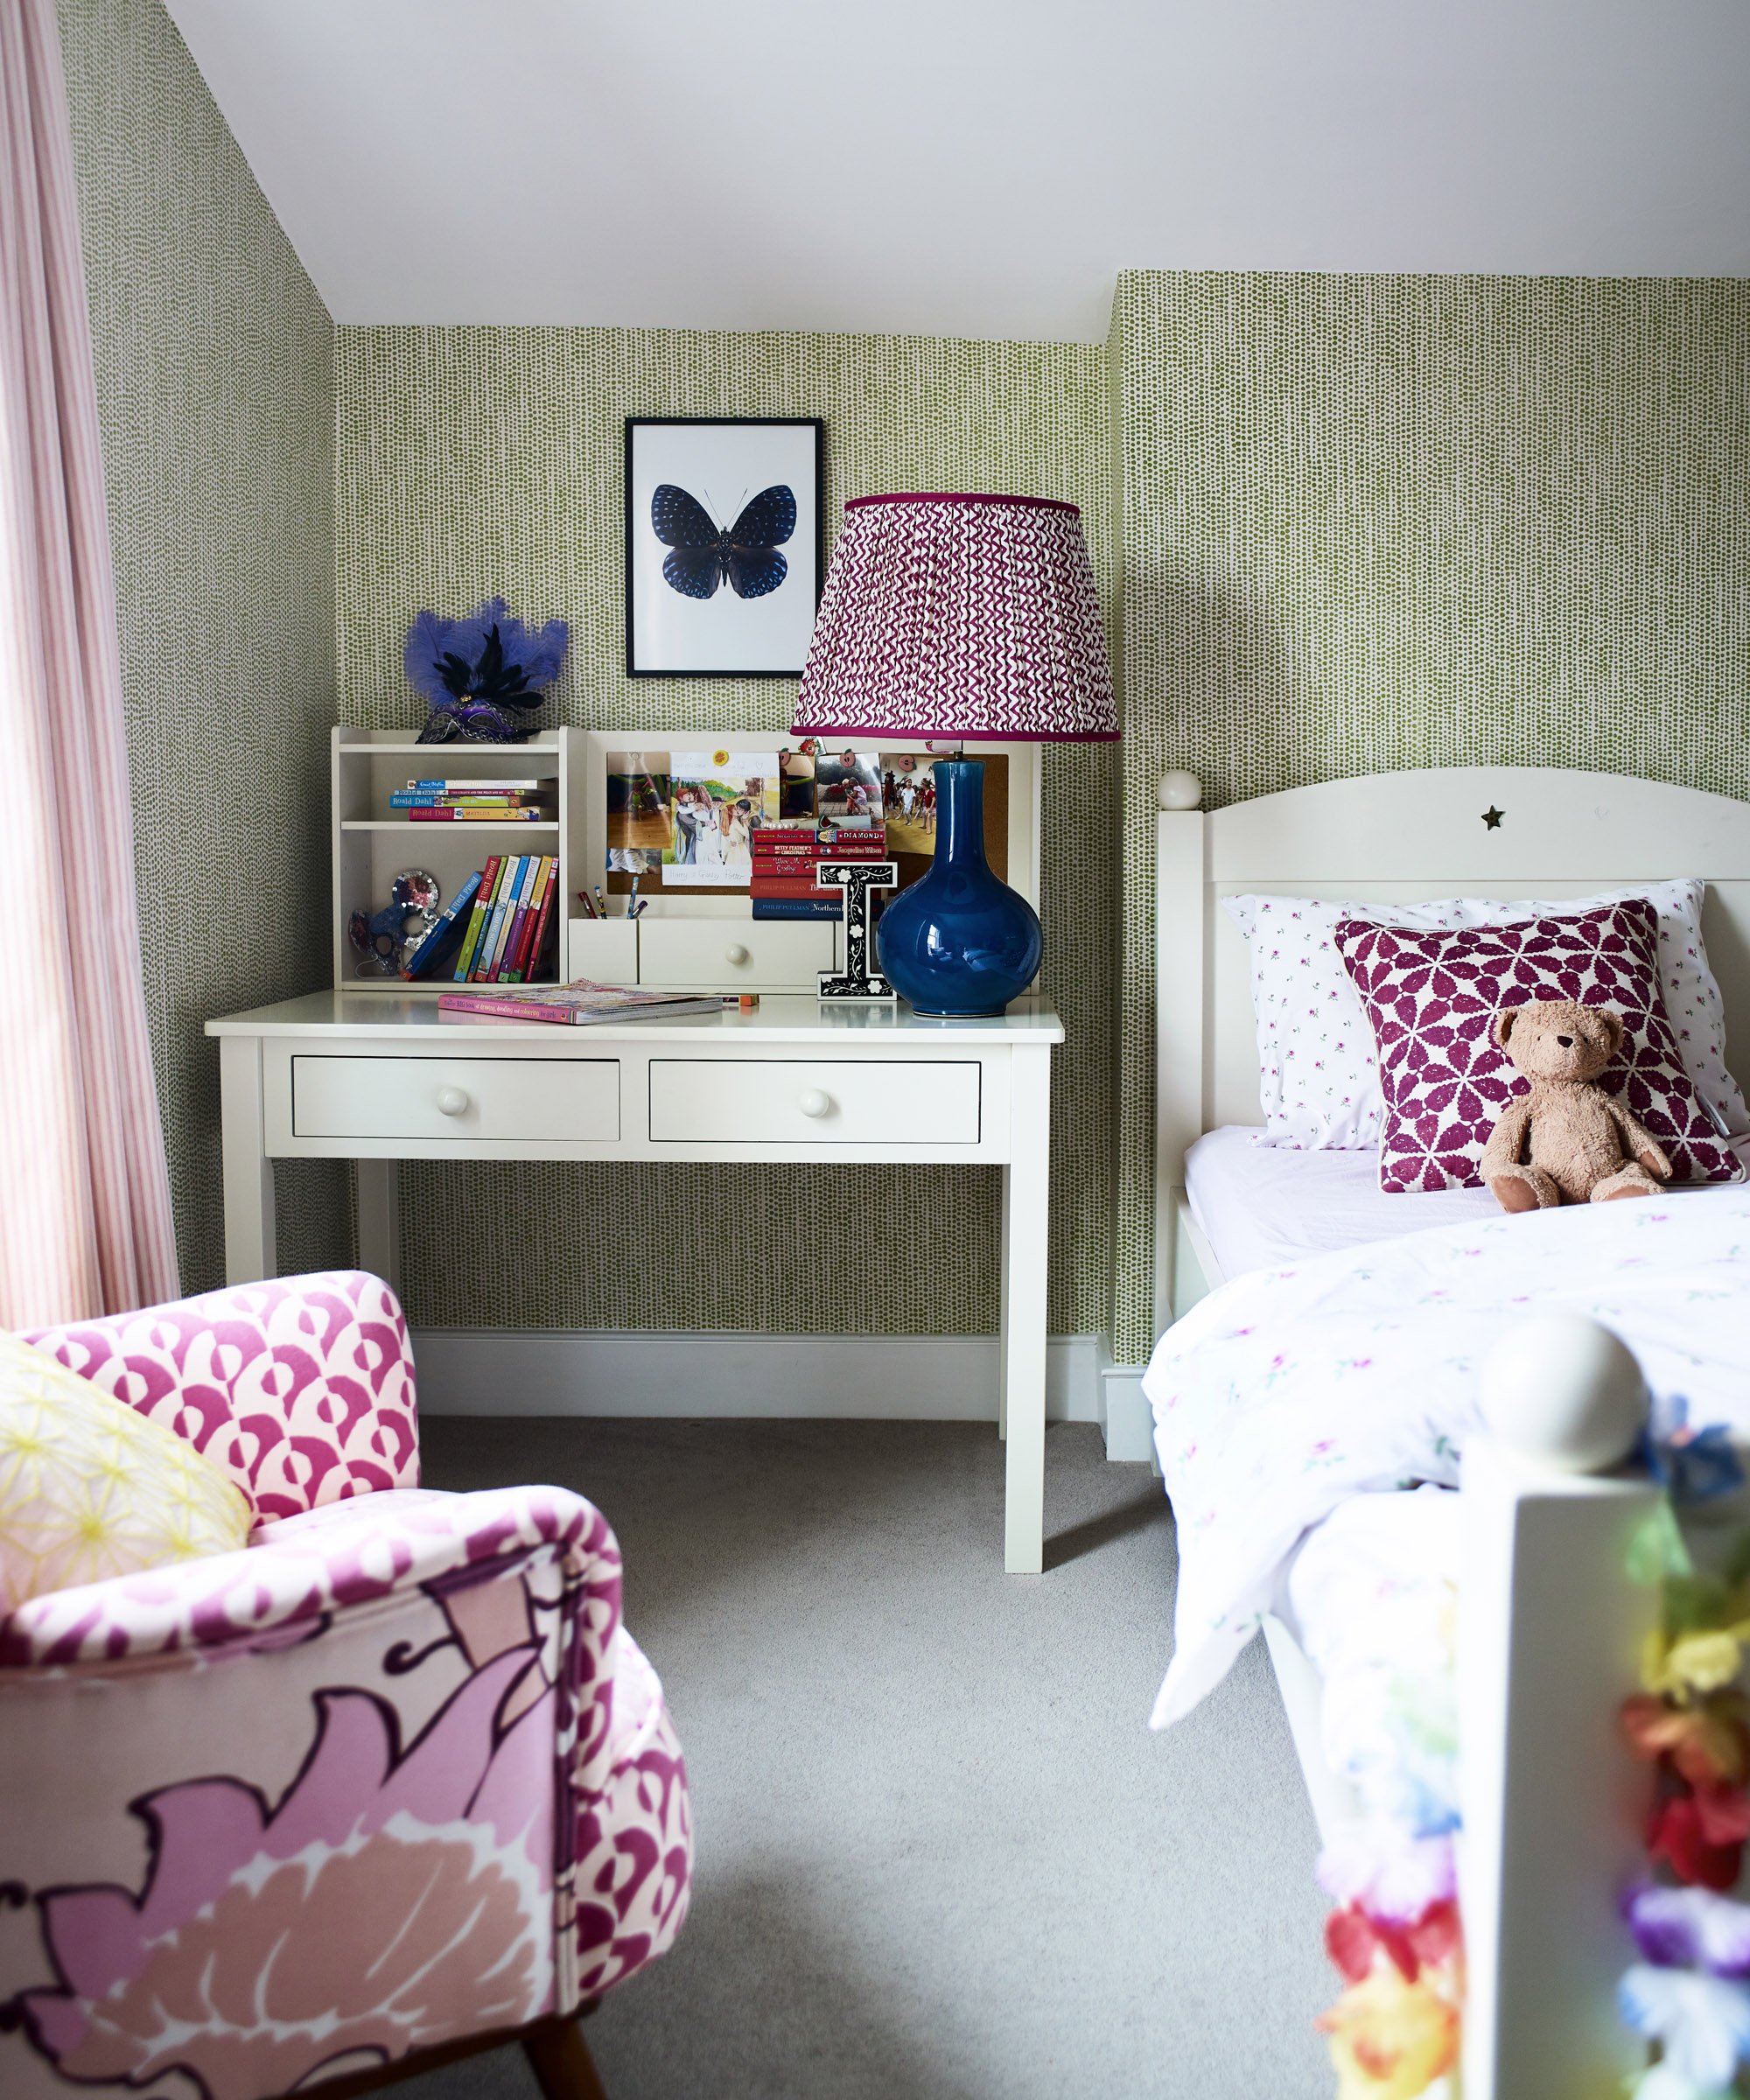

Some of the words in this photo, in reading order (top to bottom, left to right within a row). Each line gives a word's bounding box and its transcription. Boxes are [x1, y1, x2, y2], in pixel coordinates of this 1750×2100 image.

[486, 859, 496, 879] Roald
[505, 859, 516, 879] Roald
[517, 858, 527, 878] Roald
[527, 859, 537, 878] Roald
[539, 859, 550, 879] Roald
[670, 869, 687, 881] Harry
[725, 869, 748, 880] Potter
[463, 876, 479, 894] Roald
[480, 881, 490, 899] Dahl
[500, 881, 510, 898] Dahl
[512, 881, 521, 898] Dahl
[522, 881, 532, 898] Dahl
[534, 881, 543, 898] Dahl
[451, 893, 466, 911] Dahl
[814, 903, 841, 912] Northern
[480, 911, 490, 932] FANTASTIC
[491, 912, 500, 931] GOING
[486, 931, 495, 949] SOLO
[497, 1006, 514, 1015] doodling
[520, 1008, 539, 1018] colouring
